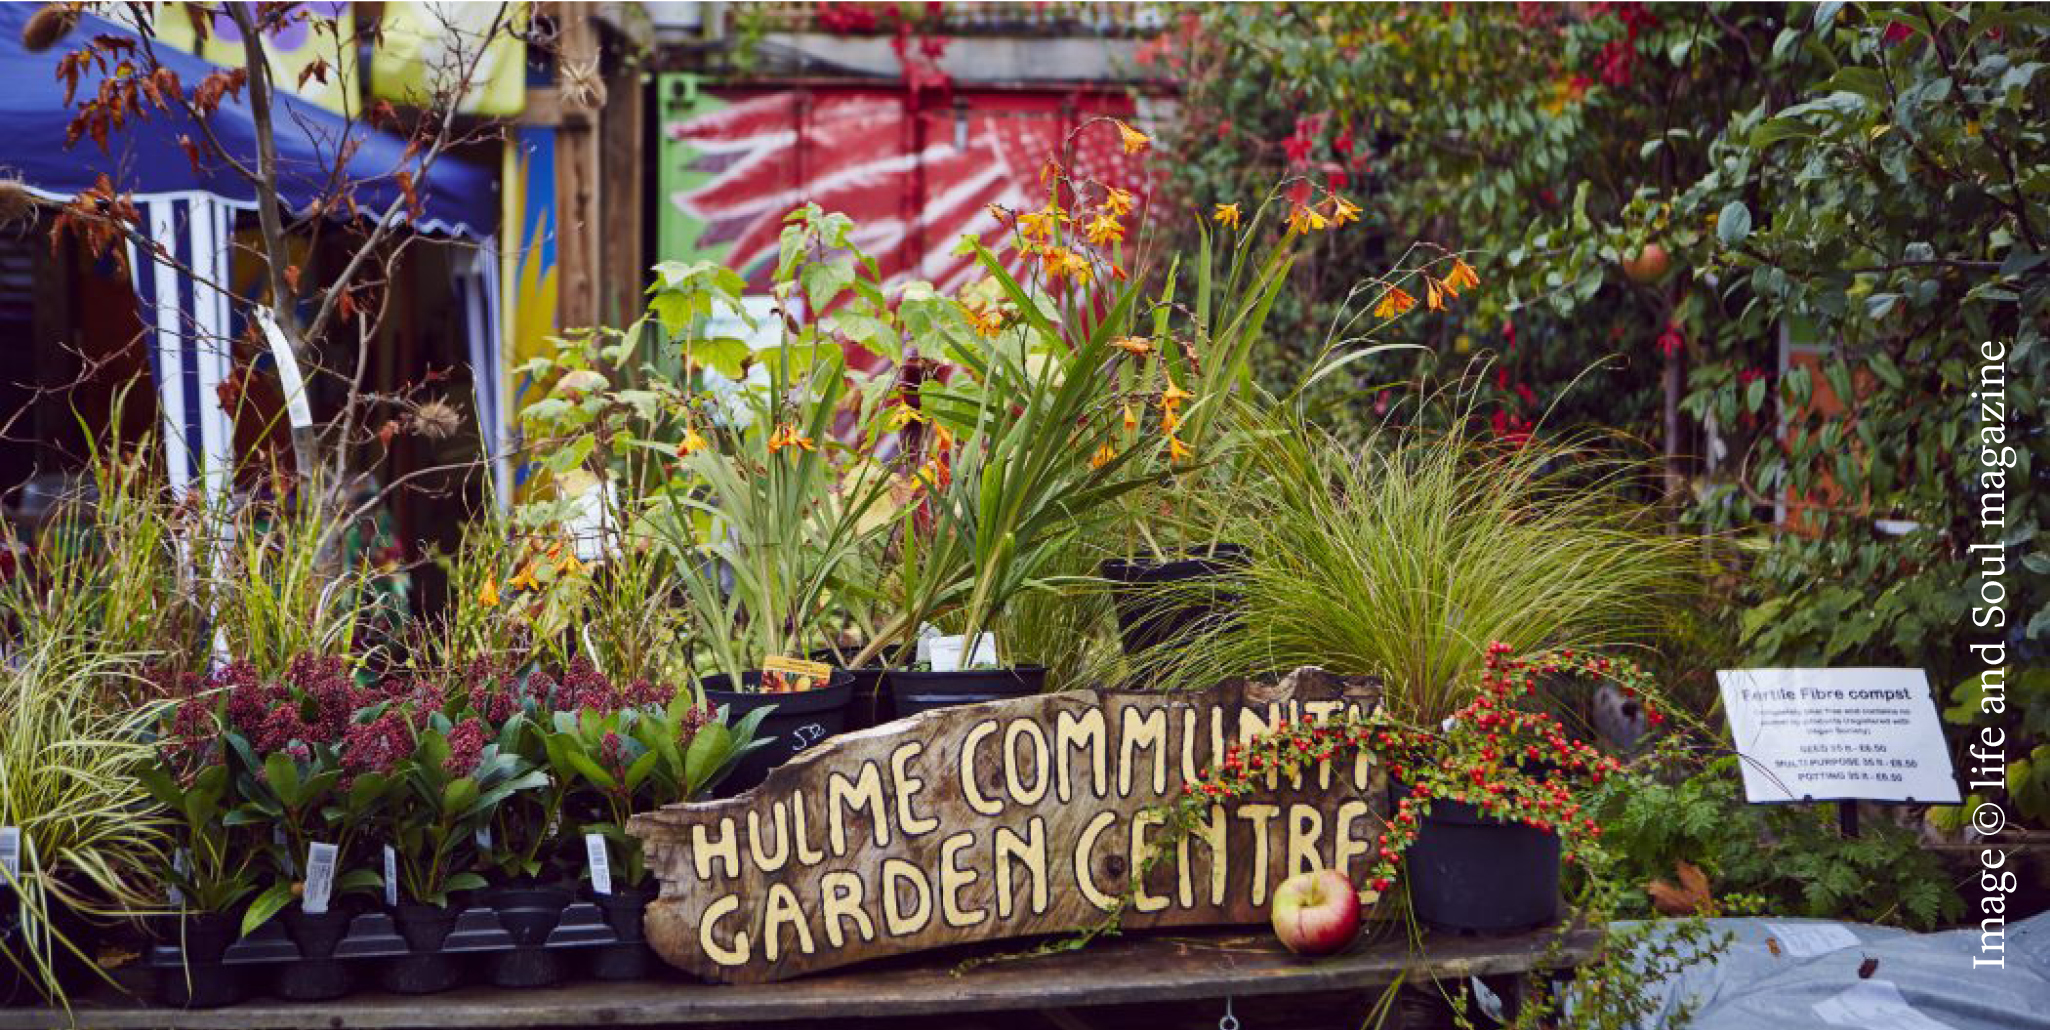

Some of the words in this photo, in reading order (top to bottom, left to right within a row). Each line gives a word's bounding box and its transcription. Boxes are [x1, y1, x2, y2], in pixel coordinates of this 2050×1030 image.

[1800, 686, 1844, 701] Fibre
[692, 742, 939, 880] HULME
[699, 816, 1047, 966] GARDEN
[1074, 801, 1379, 911] CENTRE
